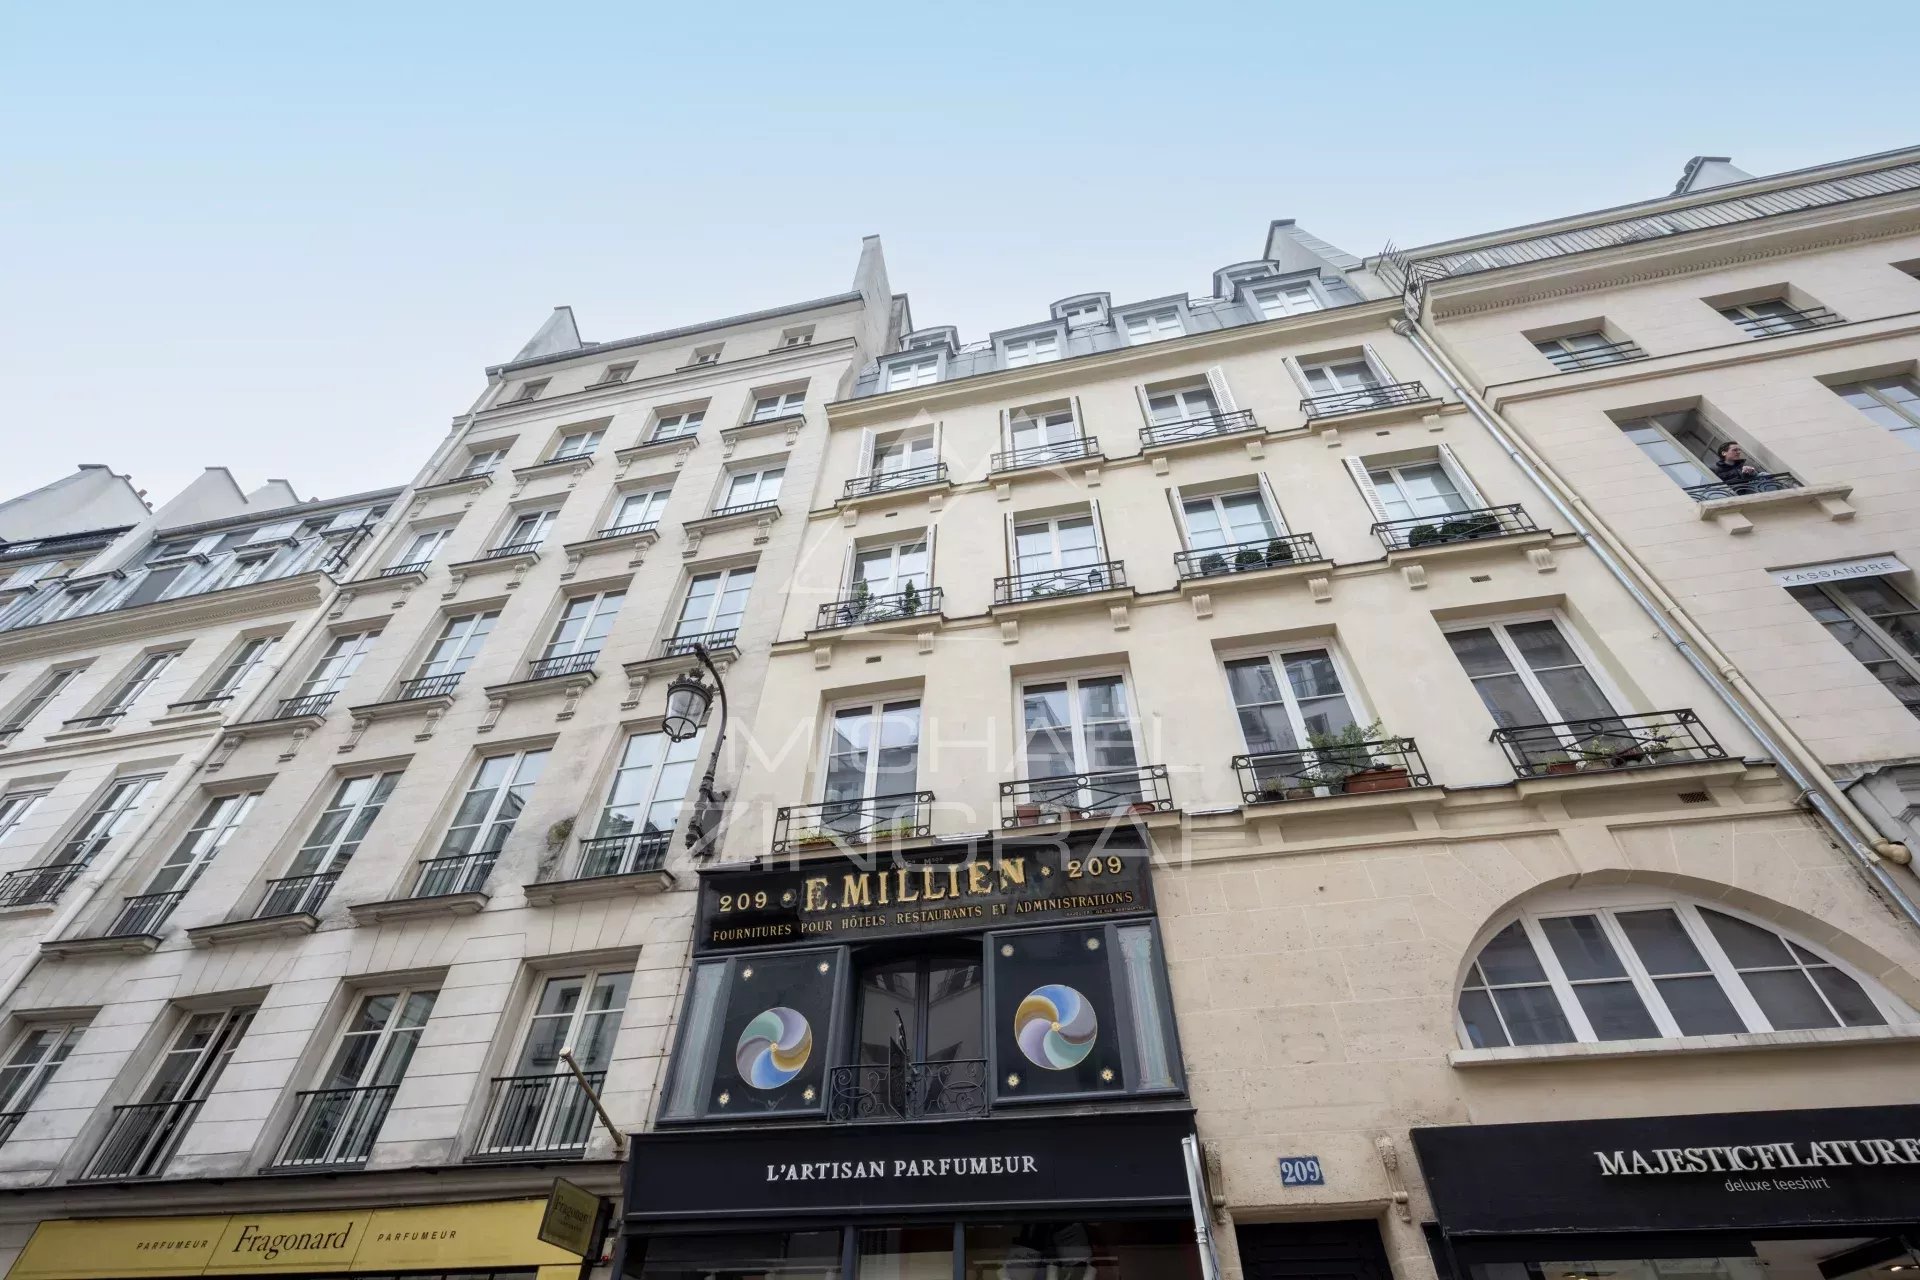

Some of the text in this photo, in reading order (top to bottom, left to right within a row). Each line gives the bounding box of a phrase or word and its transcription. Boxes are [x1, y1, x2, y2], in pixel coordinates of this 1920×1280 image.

[1782, 562, 1893, 582] KASSANDRE
[719, 891, 768, 912] 209
[1067, 856, 1123, 878] 209
[713, 924, 792, 942] FOURNITURES
[801, 920, 833, 933] POUR
[841, 915, 886, 929] HÔTELS
[896, 905, 982, 924] RESTAURANTS
[992, 904, 1007, 915] ET
[1016, 891, 1134, 913] ADMINISTRATIONS
[766, 1155, 1038, 1181] L'ARTISAN PARFUMEUR
[1281, 1160, 1321, 1183] 209
[1593, 1138, 1920, 1176] MAJESTICFILATURE
[1724, 1176, 1831, 1193] deluxe teeshirt
[136, 1222, 457, 1261] PARFUMEUR Fragonard PARFUMEUR
